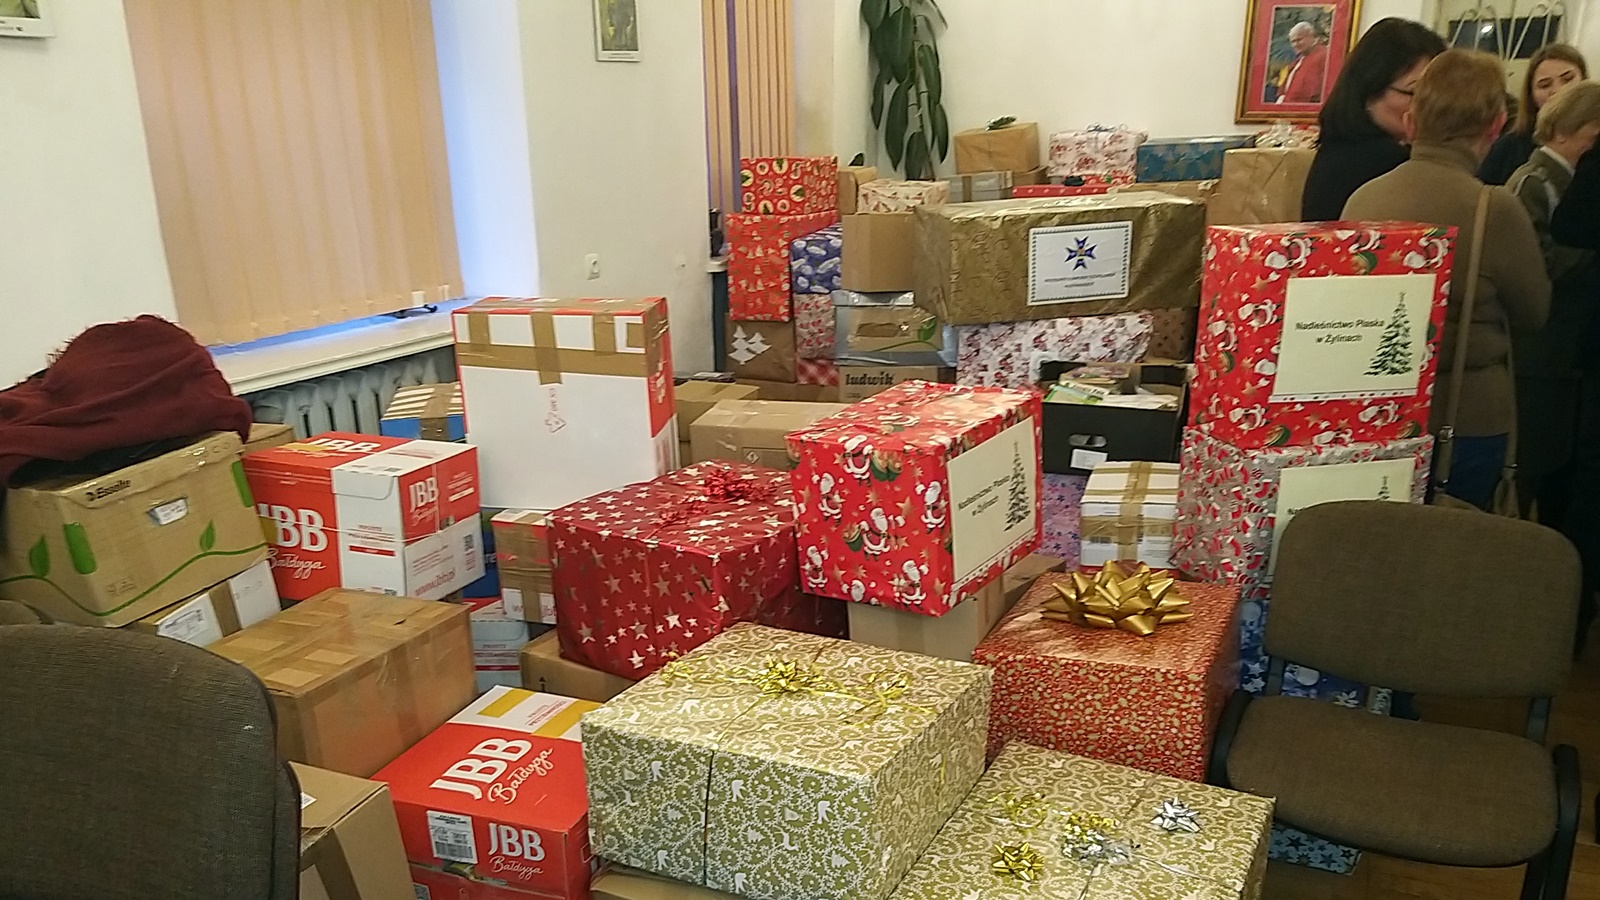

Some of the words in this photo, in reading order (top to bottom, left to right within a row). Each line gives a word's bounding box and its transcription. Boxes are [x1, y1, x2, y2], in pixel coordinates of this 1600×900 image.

[408, 476, 439, 513] JBB
[429, 738, 532, 801] JBB
[488, 823, 546, 862] JBB
